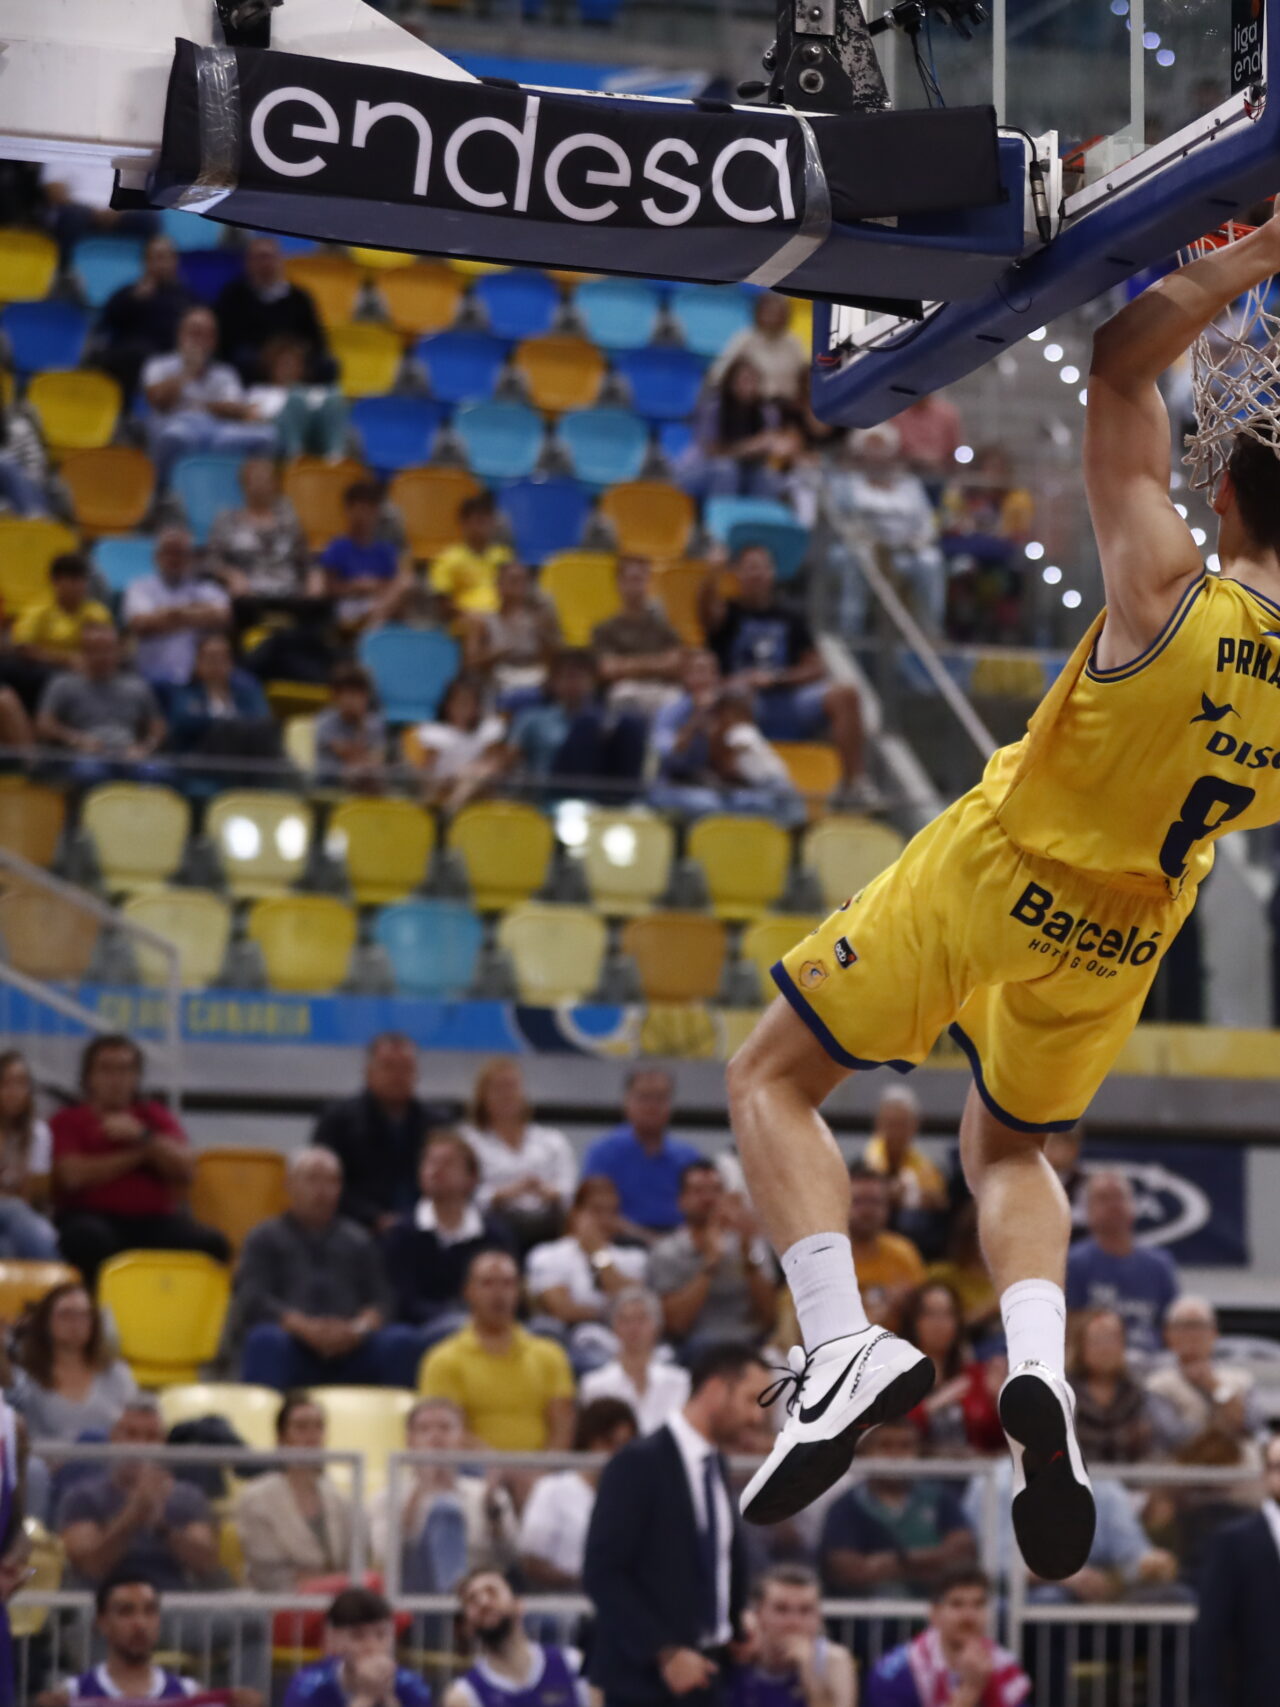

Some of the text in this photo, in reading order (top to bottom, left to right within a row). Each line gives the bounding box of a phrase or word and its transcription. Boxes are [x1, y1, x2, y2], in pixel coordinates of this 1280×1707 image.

[1233, 21, 1258, 54] liga
[250, 86, 796, 227] endesa
[1070, 956, 1118, 979] GOUP
